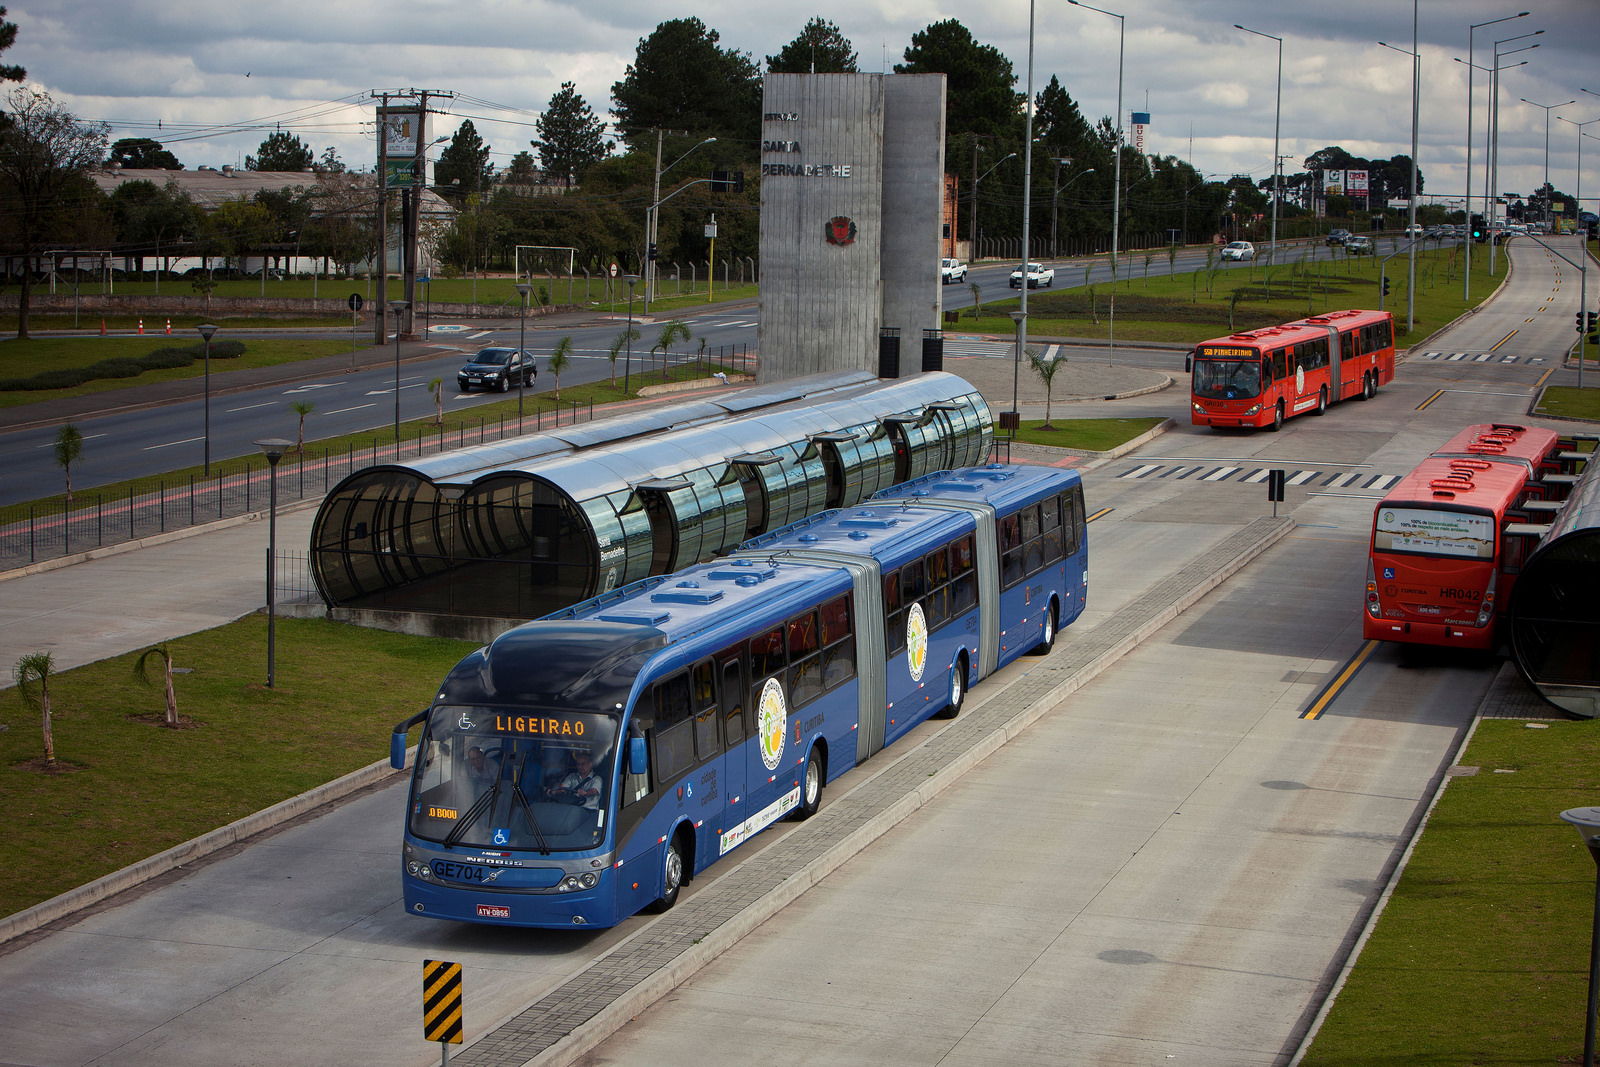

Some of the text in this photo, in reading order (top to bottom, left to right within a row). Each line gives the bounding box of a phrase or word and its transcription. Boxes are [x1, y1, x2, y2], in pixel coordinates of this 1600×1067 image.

[763, 140, 801, 153] SANTA
[762, 163, 851, 178] BERNADETHE
[1440, 587, 1480, 601] HR042
[496, 715, 585, 736] LIGEIRAO
[804, 712, 825, 733] CURITIBA
[701, 768, 716, 785] cidade
[711, 779, 716, 789] de
[701, 789, 718, 807] curitiba
[434, 862, 483, 882] GE704
